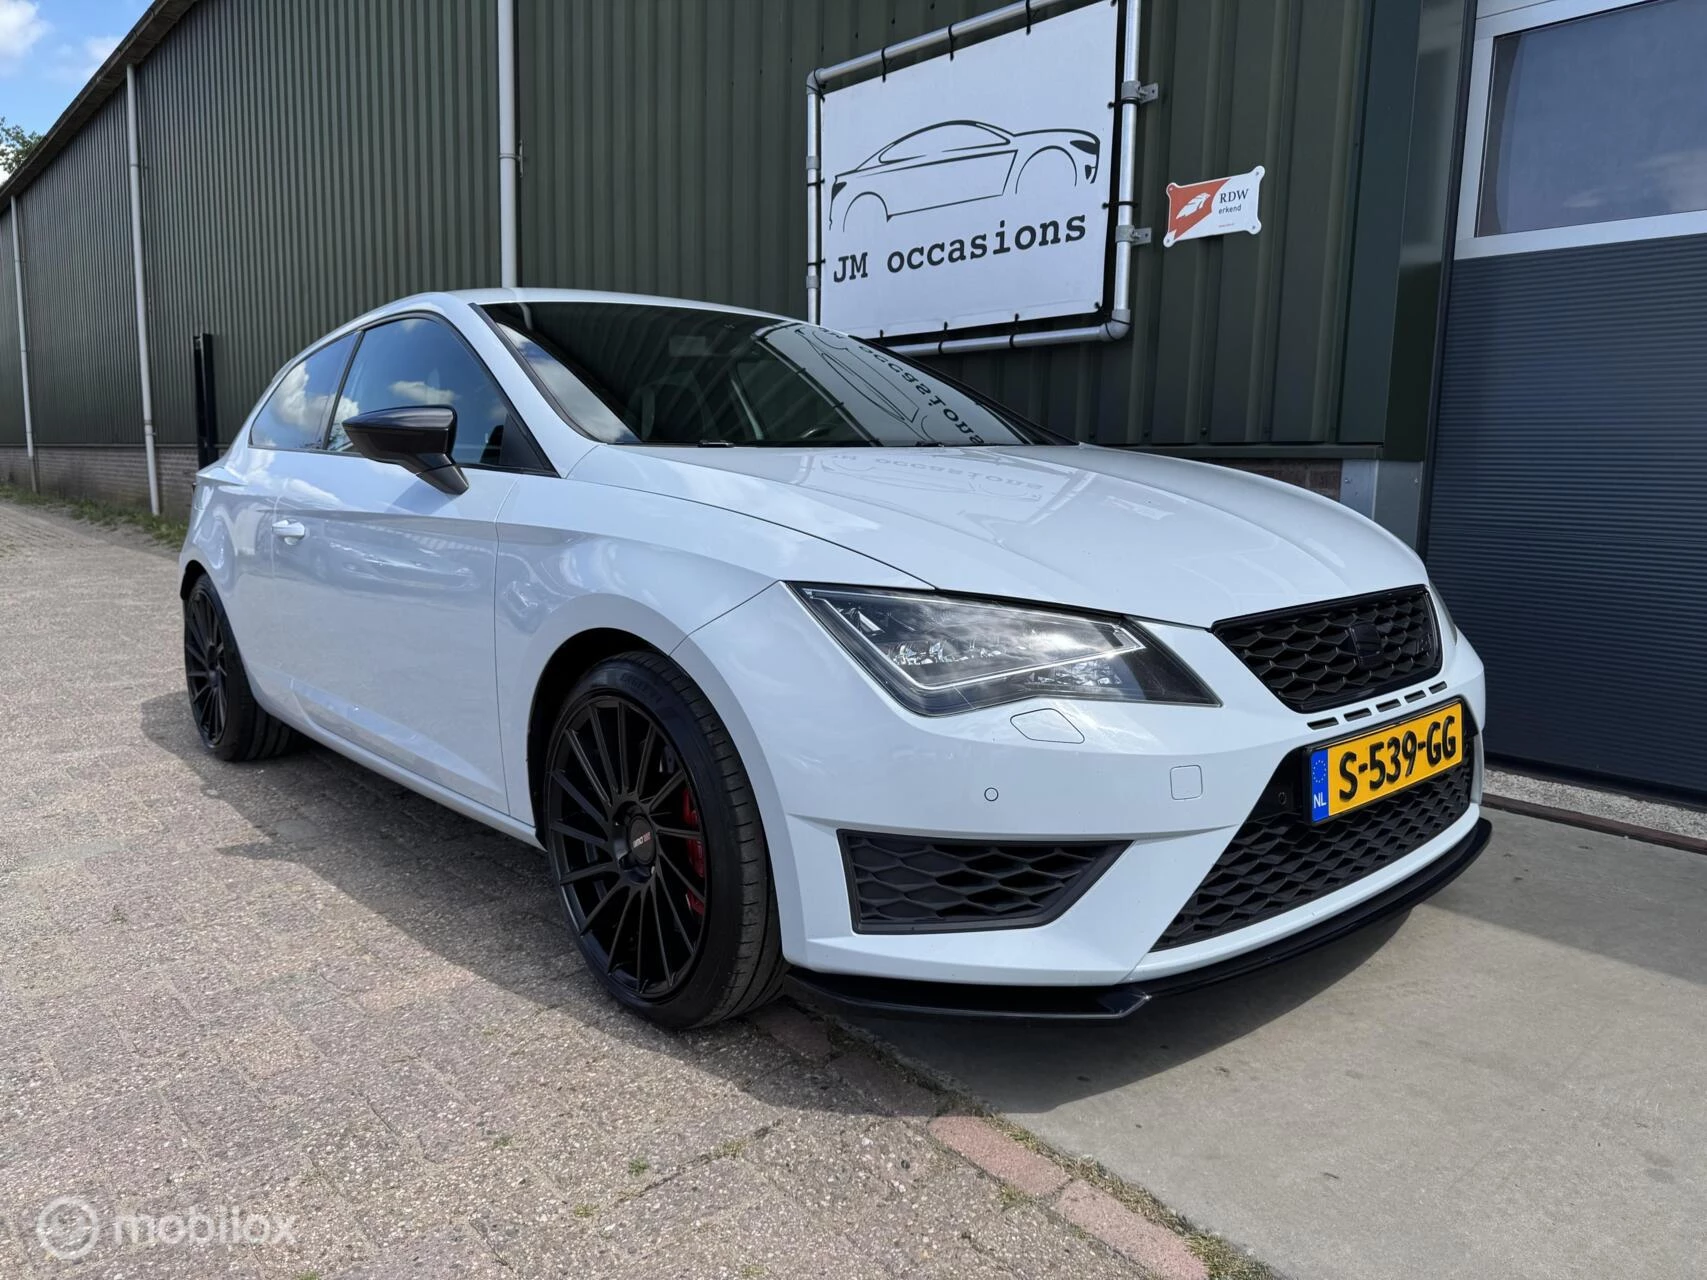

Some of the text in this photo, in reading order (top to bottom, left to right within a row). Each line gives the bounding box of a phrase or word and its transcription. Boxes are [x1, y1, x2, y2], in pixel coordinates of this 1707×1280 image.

[1219, 188, 1249, 204] RDW
[1218, 204, 1242, 215] erkend
[833, 214, 1086, 283] JM occasions
[1339, 715, 1456, 802] S-539-GG
[1313, 791, 1327, 809] NL
